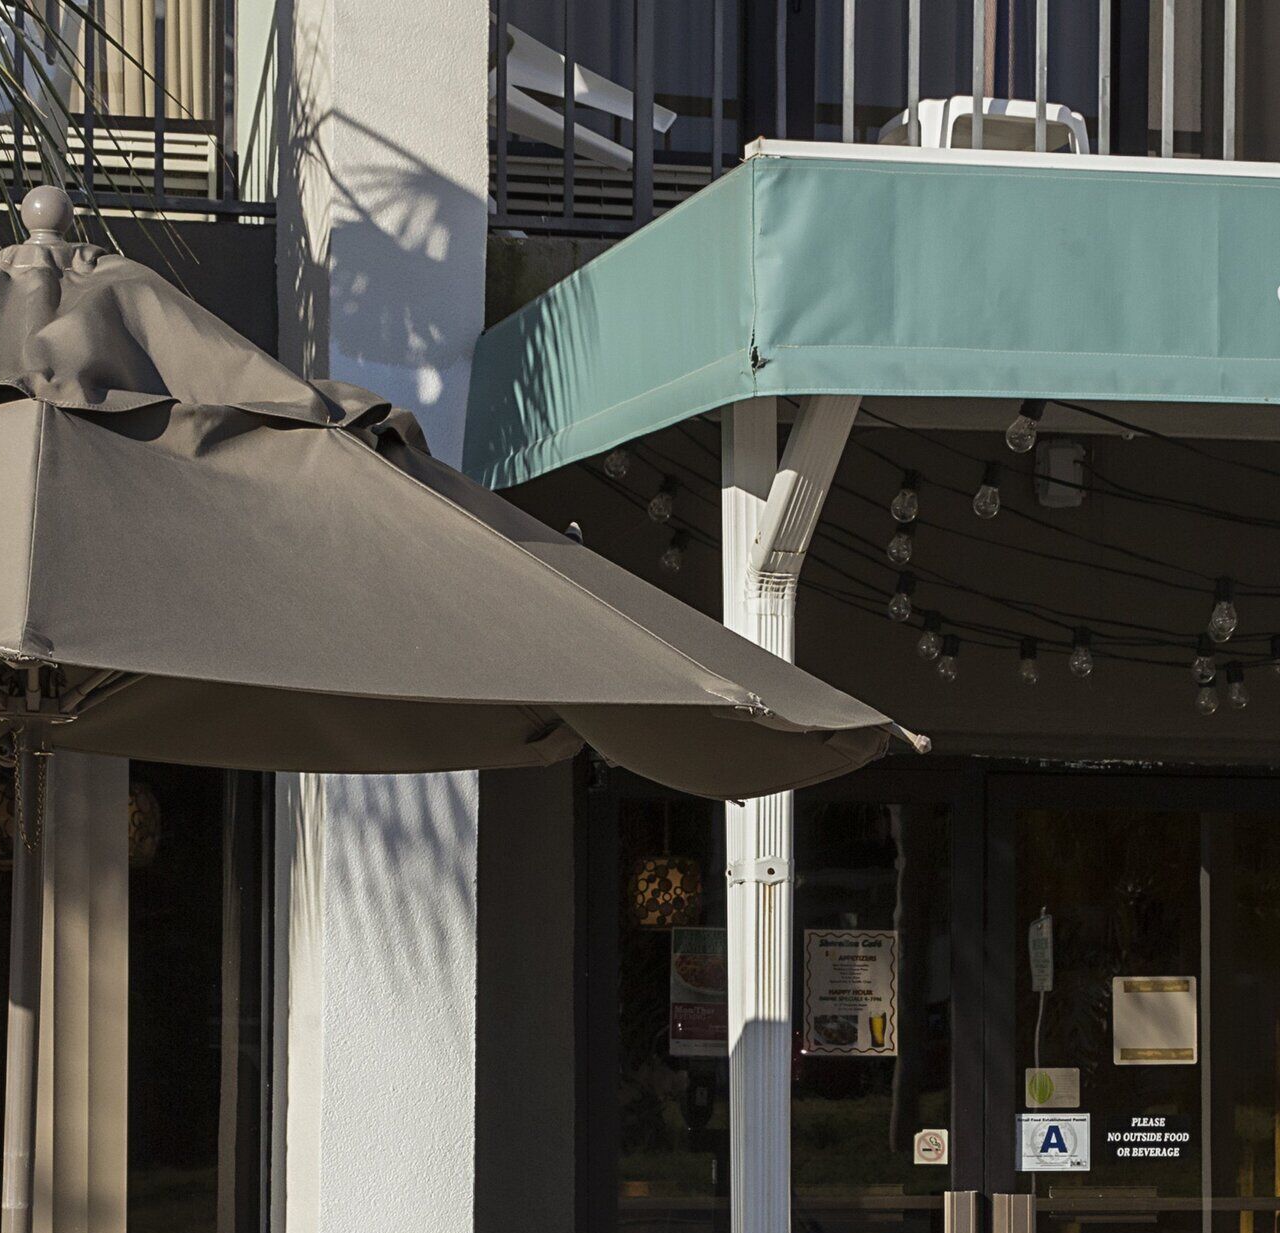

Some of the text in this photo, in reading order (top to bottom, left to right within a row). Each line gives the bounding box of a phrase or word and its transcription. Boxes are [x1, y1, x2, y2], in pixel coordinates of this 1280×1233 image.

[1131, 1117, 1166, 1127] PLEASE
[1039, 1125, 1069, 1154] A
[1107, 1132, 1190, 1142] NO OUTSIDE FOOD
[1116, 1147, 1180, 1157] OR BEVERAGE
